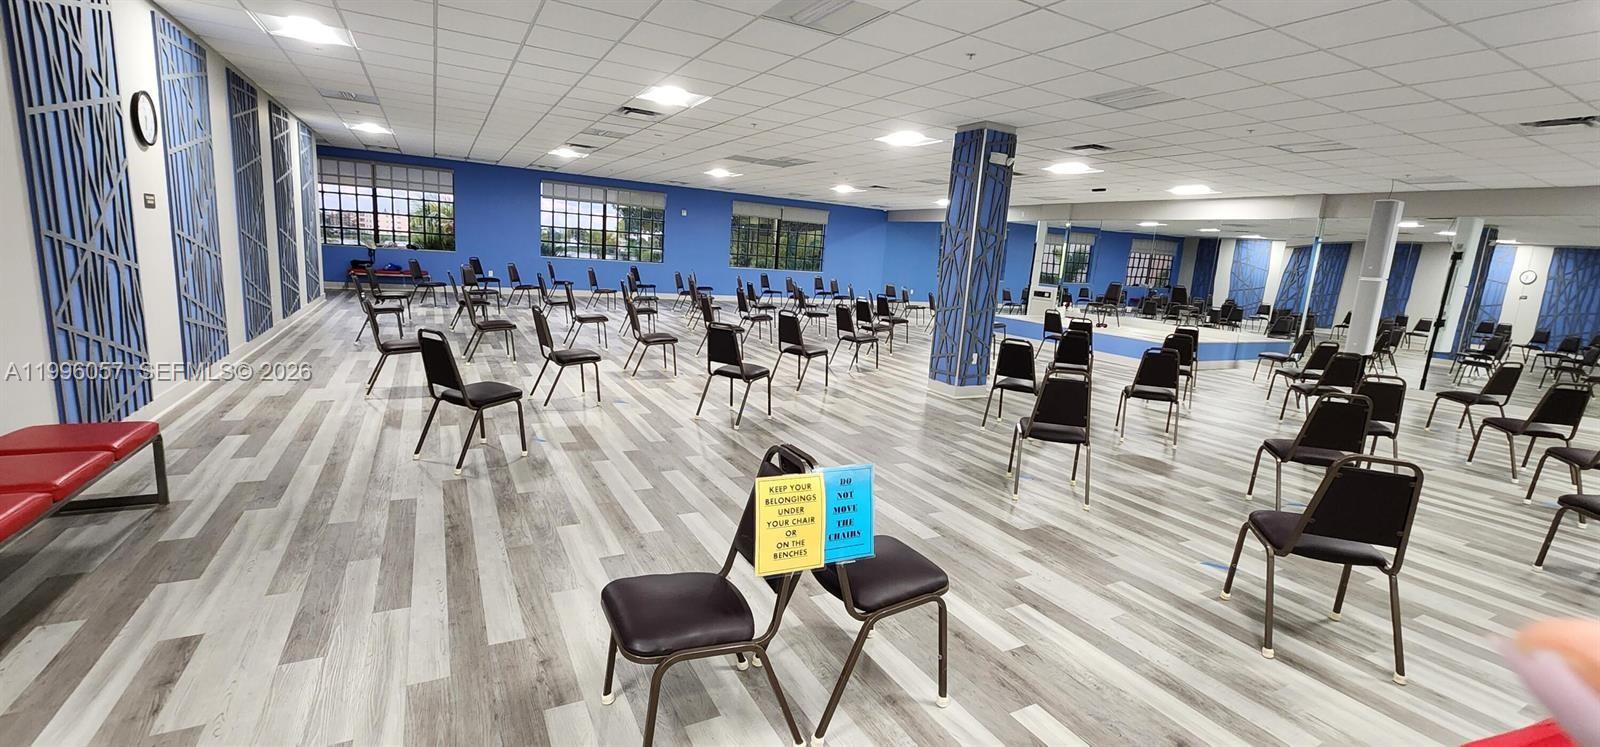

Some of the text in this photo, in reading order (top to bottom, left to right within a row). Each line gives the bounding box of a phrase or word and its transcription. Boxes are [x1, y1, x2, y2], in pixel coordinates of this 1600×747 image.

[769, 485, 787, 493] KEEP
[765, 494, 816, 505] BELONGINGS
[837, 491, 854, 499] NOT
[778, 507, 804, 515] UNDER
[833, 504, 858, 513] MOVE
[767, 517, 815, 527] YOUR CHAIR
[837, 518, 854, 528] THE
[828, 530, 861, 541] CHAIRS
[792, 539, 805, 547] THE
[773, 549, 808, 559] BENCHES
